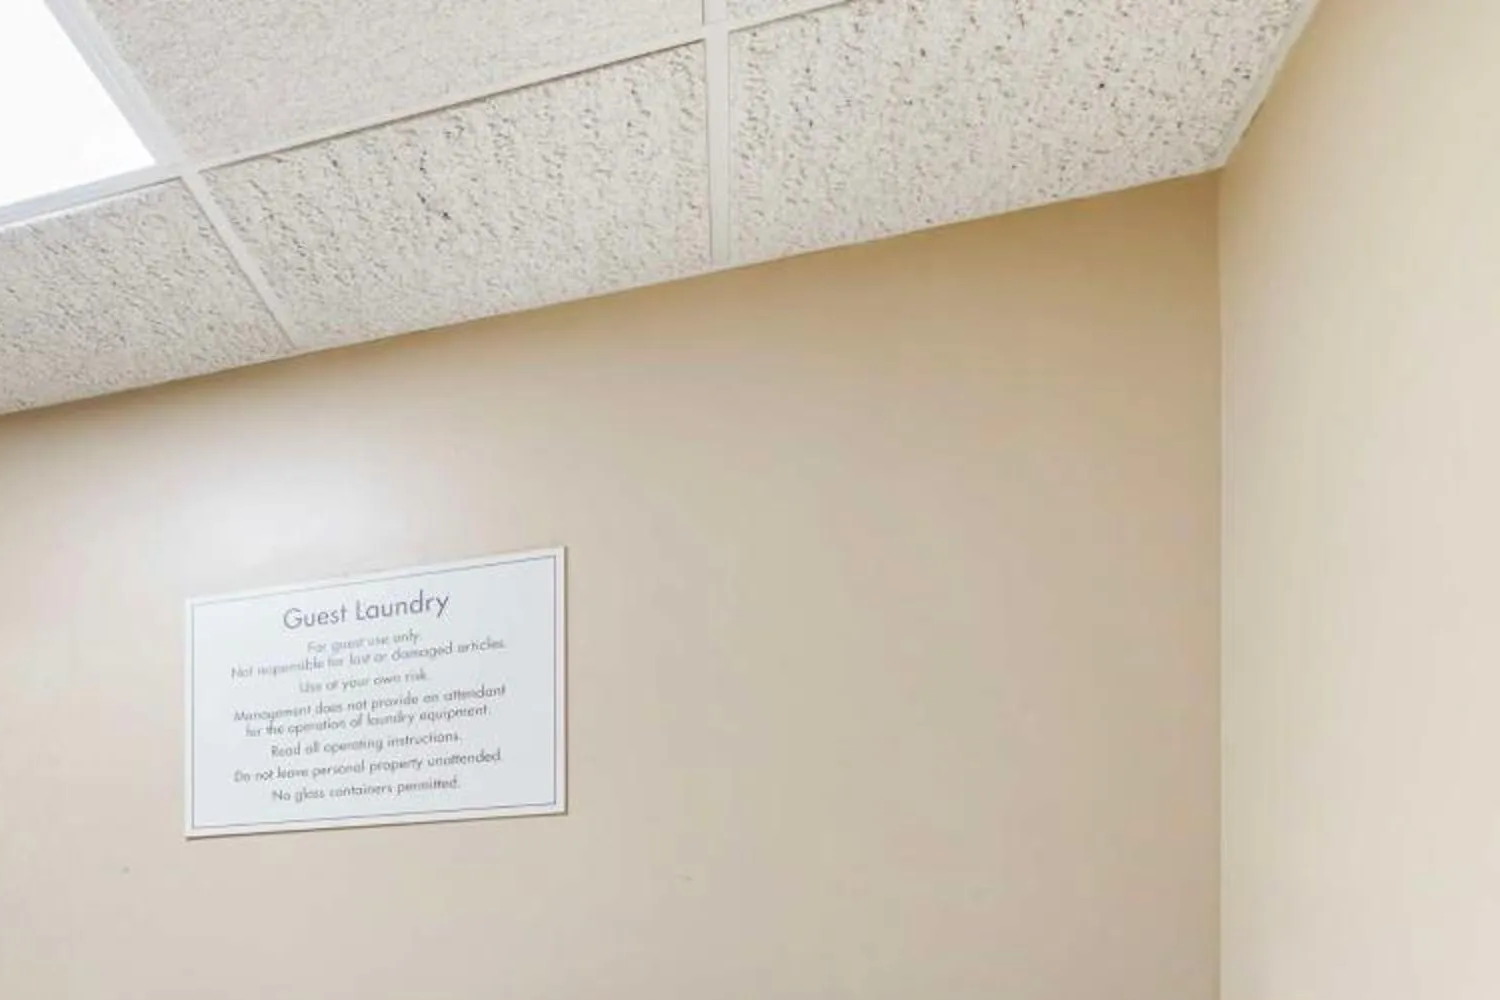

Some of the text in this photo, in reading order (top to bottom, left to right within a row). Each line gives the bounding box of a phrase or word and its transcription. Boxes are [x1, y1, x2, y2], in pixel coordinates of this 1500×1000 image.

[284, 588, 450, 630] Guest Laundry
[307, 640, 326, 653] For
[331, 637, 364, 654] guest
[366, 636, 389, 647] use
[231, 666, 253, 679] Not
[257, 656, 325, 677] responsible
[349, 652, 371, 665] lost
[373, 652, 387, 663] or
[391, 640, 453, 662] damaged
[299, 680, 323, 694] Use
[325, 679, 339, 692] at
[342, 675, 369, 692] your
[373, 675, 401, 686] own
[233, 684, 506, 722] Management does not provide an attendant
[245, 722, 261, 737] for
[265, 719, 284, 735] the
[287, 719, 347, 737] operation
[349, 712, 363, 728] of
[367, 711, 415, 728] laundry
[271, 742, 301, 757] Read
[305, 740, 320, 755] all
[323, 736, 383, 755] operating
[233, 769, 251, 783] Do
[255, 768, 274, 781] not
[277, 765, 309, 779] leave
[311, 759, 366, 780] personal
[369, 757, 423, 776] property
[272, 775, 461, 804] No glass containers permitted.
